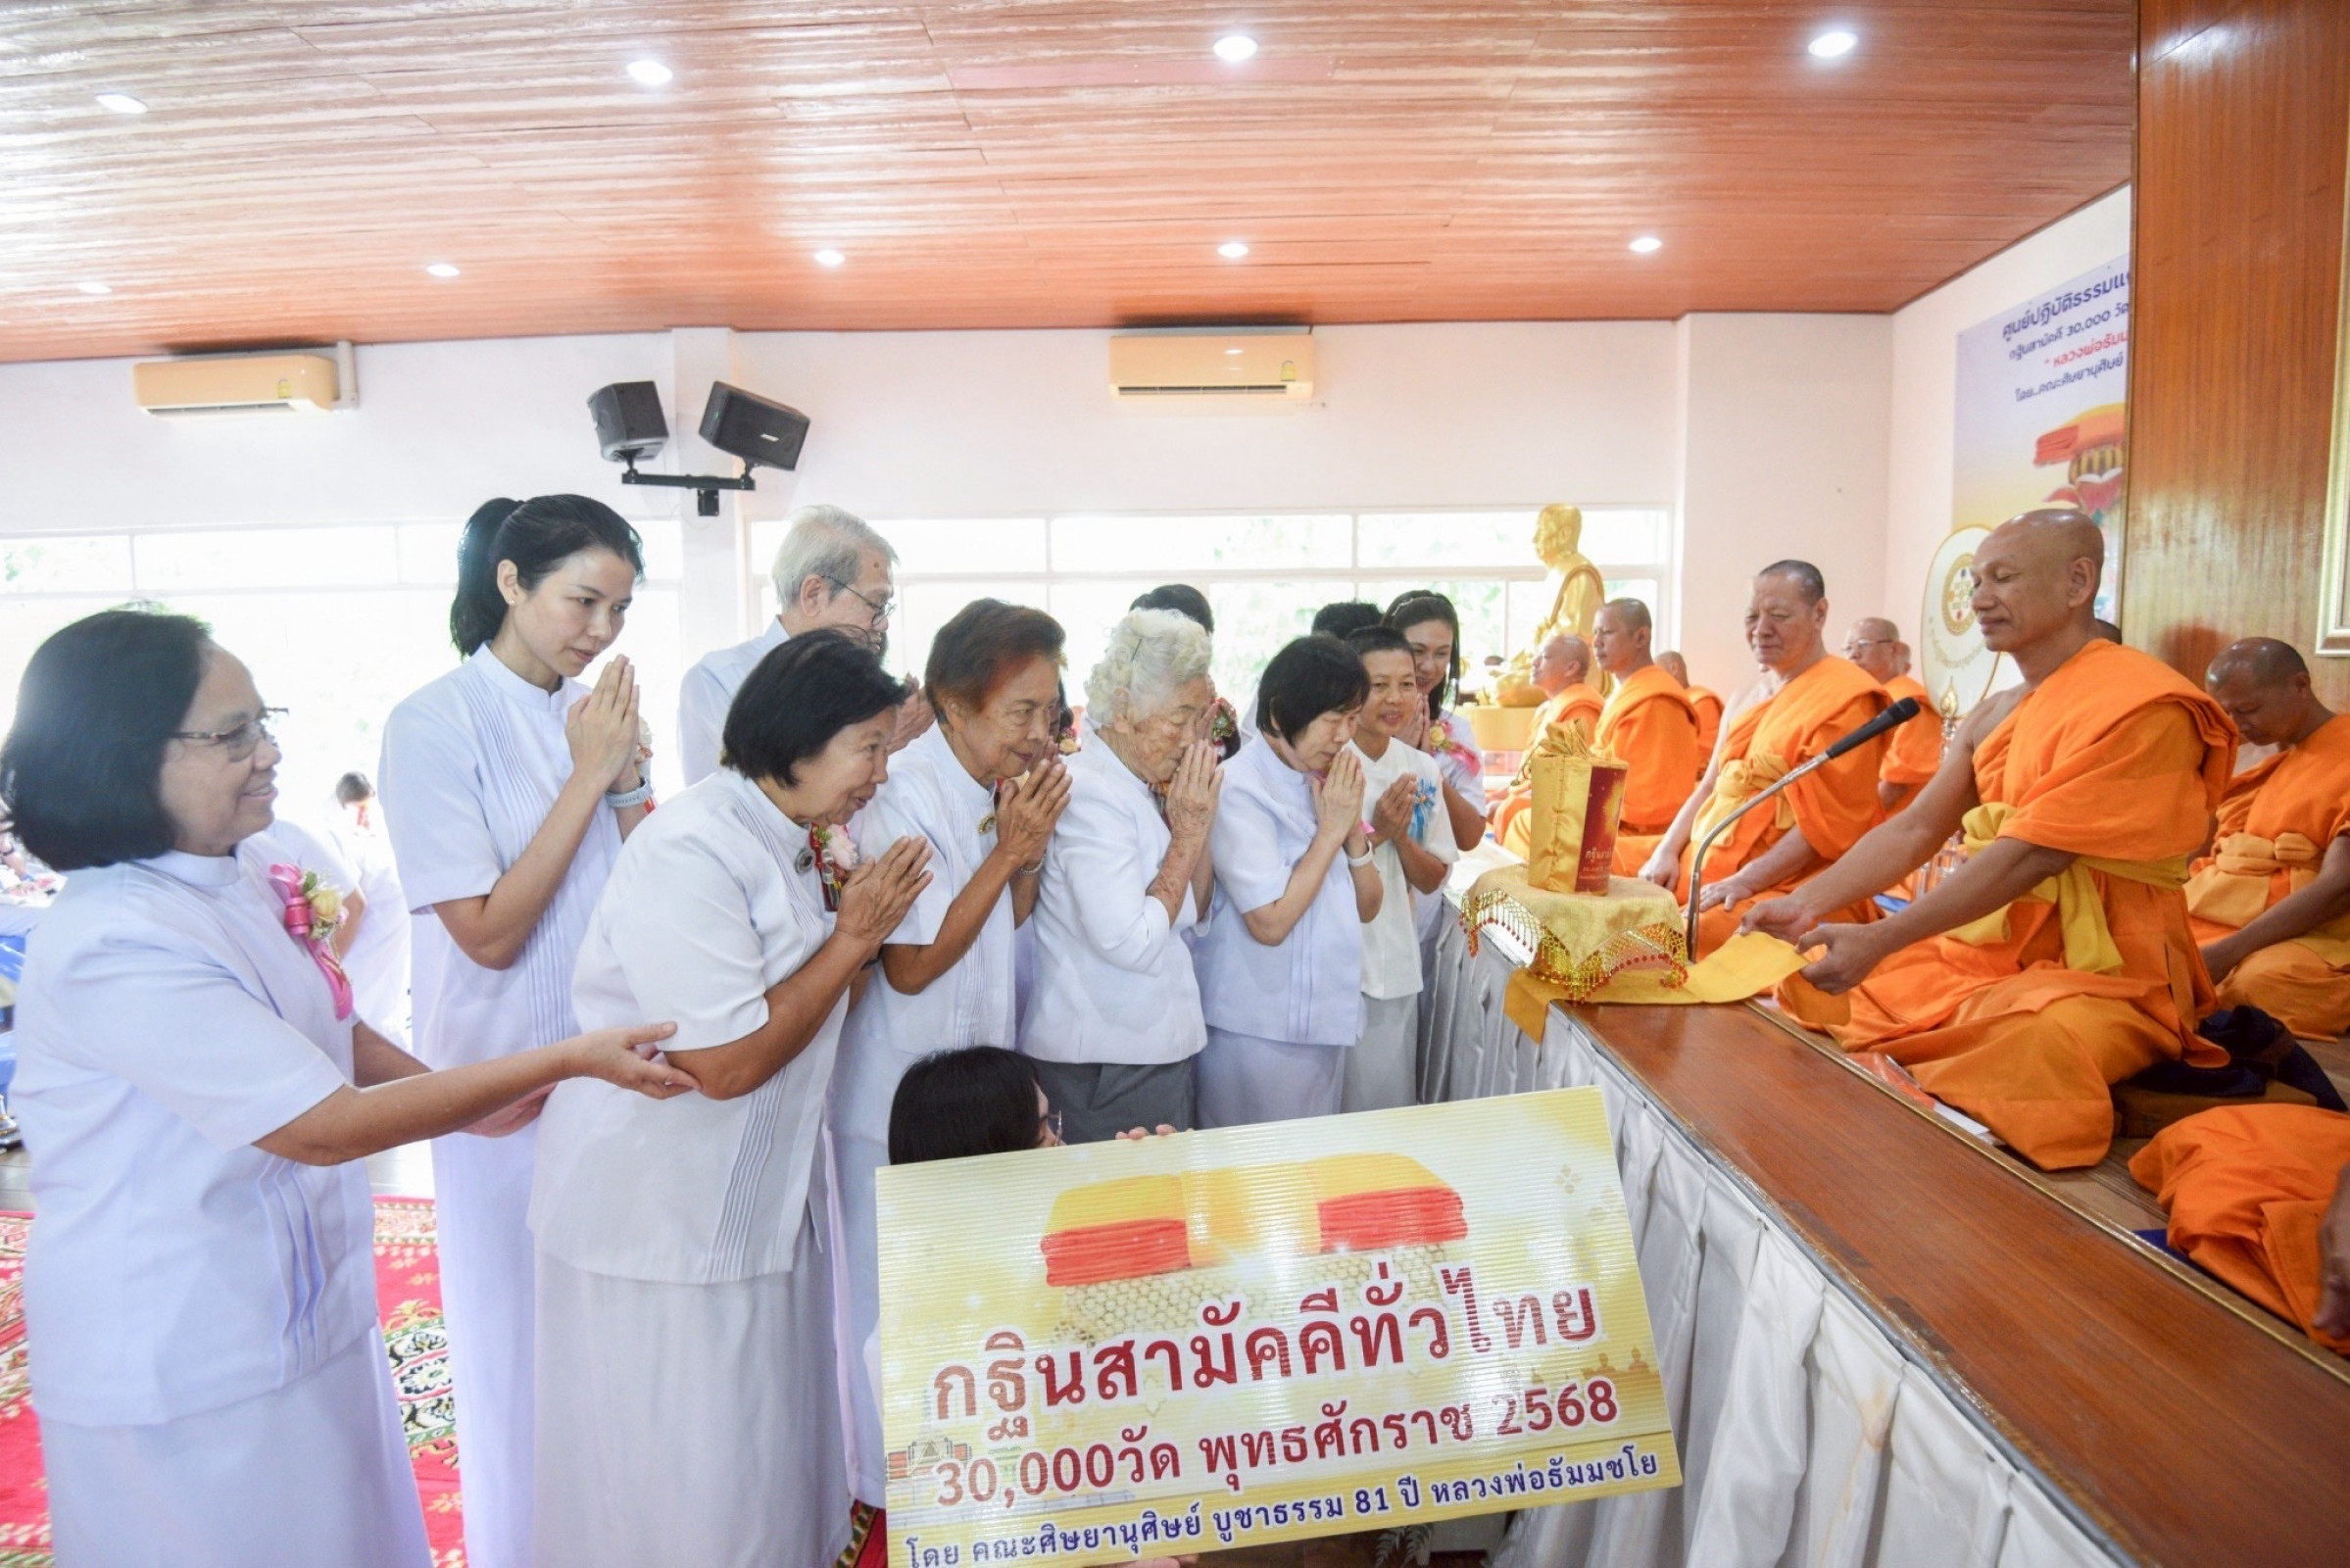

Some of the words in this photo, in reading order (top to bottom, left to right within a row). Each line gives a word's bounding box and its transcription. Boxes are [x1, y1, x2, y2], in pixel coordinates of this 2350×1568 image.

[934, 1261, 1597, 1441] กฐินสามัคคีทั่วไทย
[1199, 1400, 1474, 1492] พุทธศักราช
[1494, 1380, 1618, 1436] 2568
[906, 1537, 959, 1568] โดย
[973, 1502, 1201, 1562] คณะศิษยานุศิษย์
[1213, 1494, 1344, 1544] บูชาธรรม
[1354, 1488, 1390, 1513] 81
[1399, 1475, 1420, 1507] ปี
[1430, 1445, 1658, 1503] หลวงพ่อธัมมชโย
